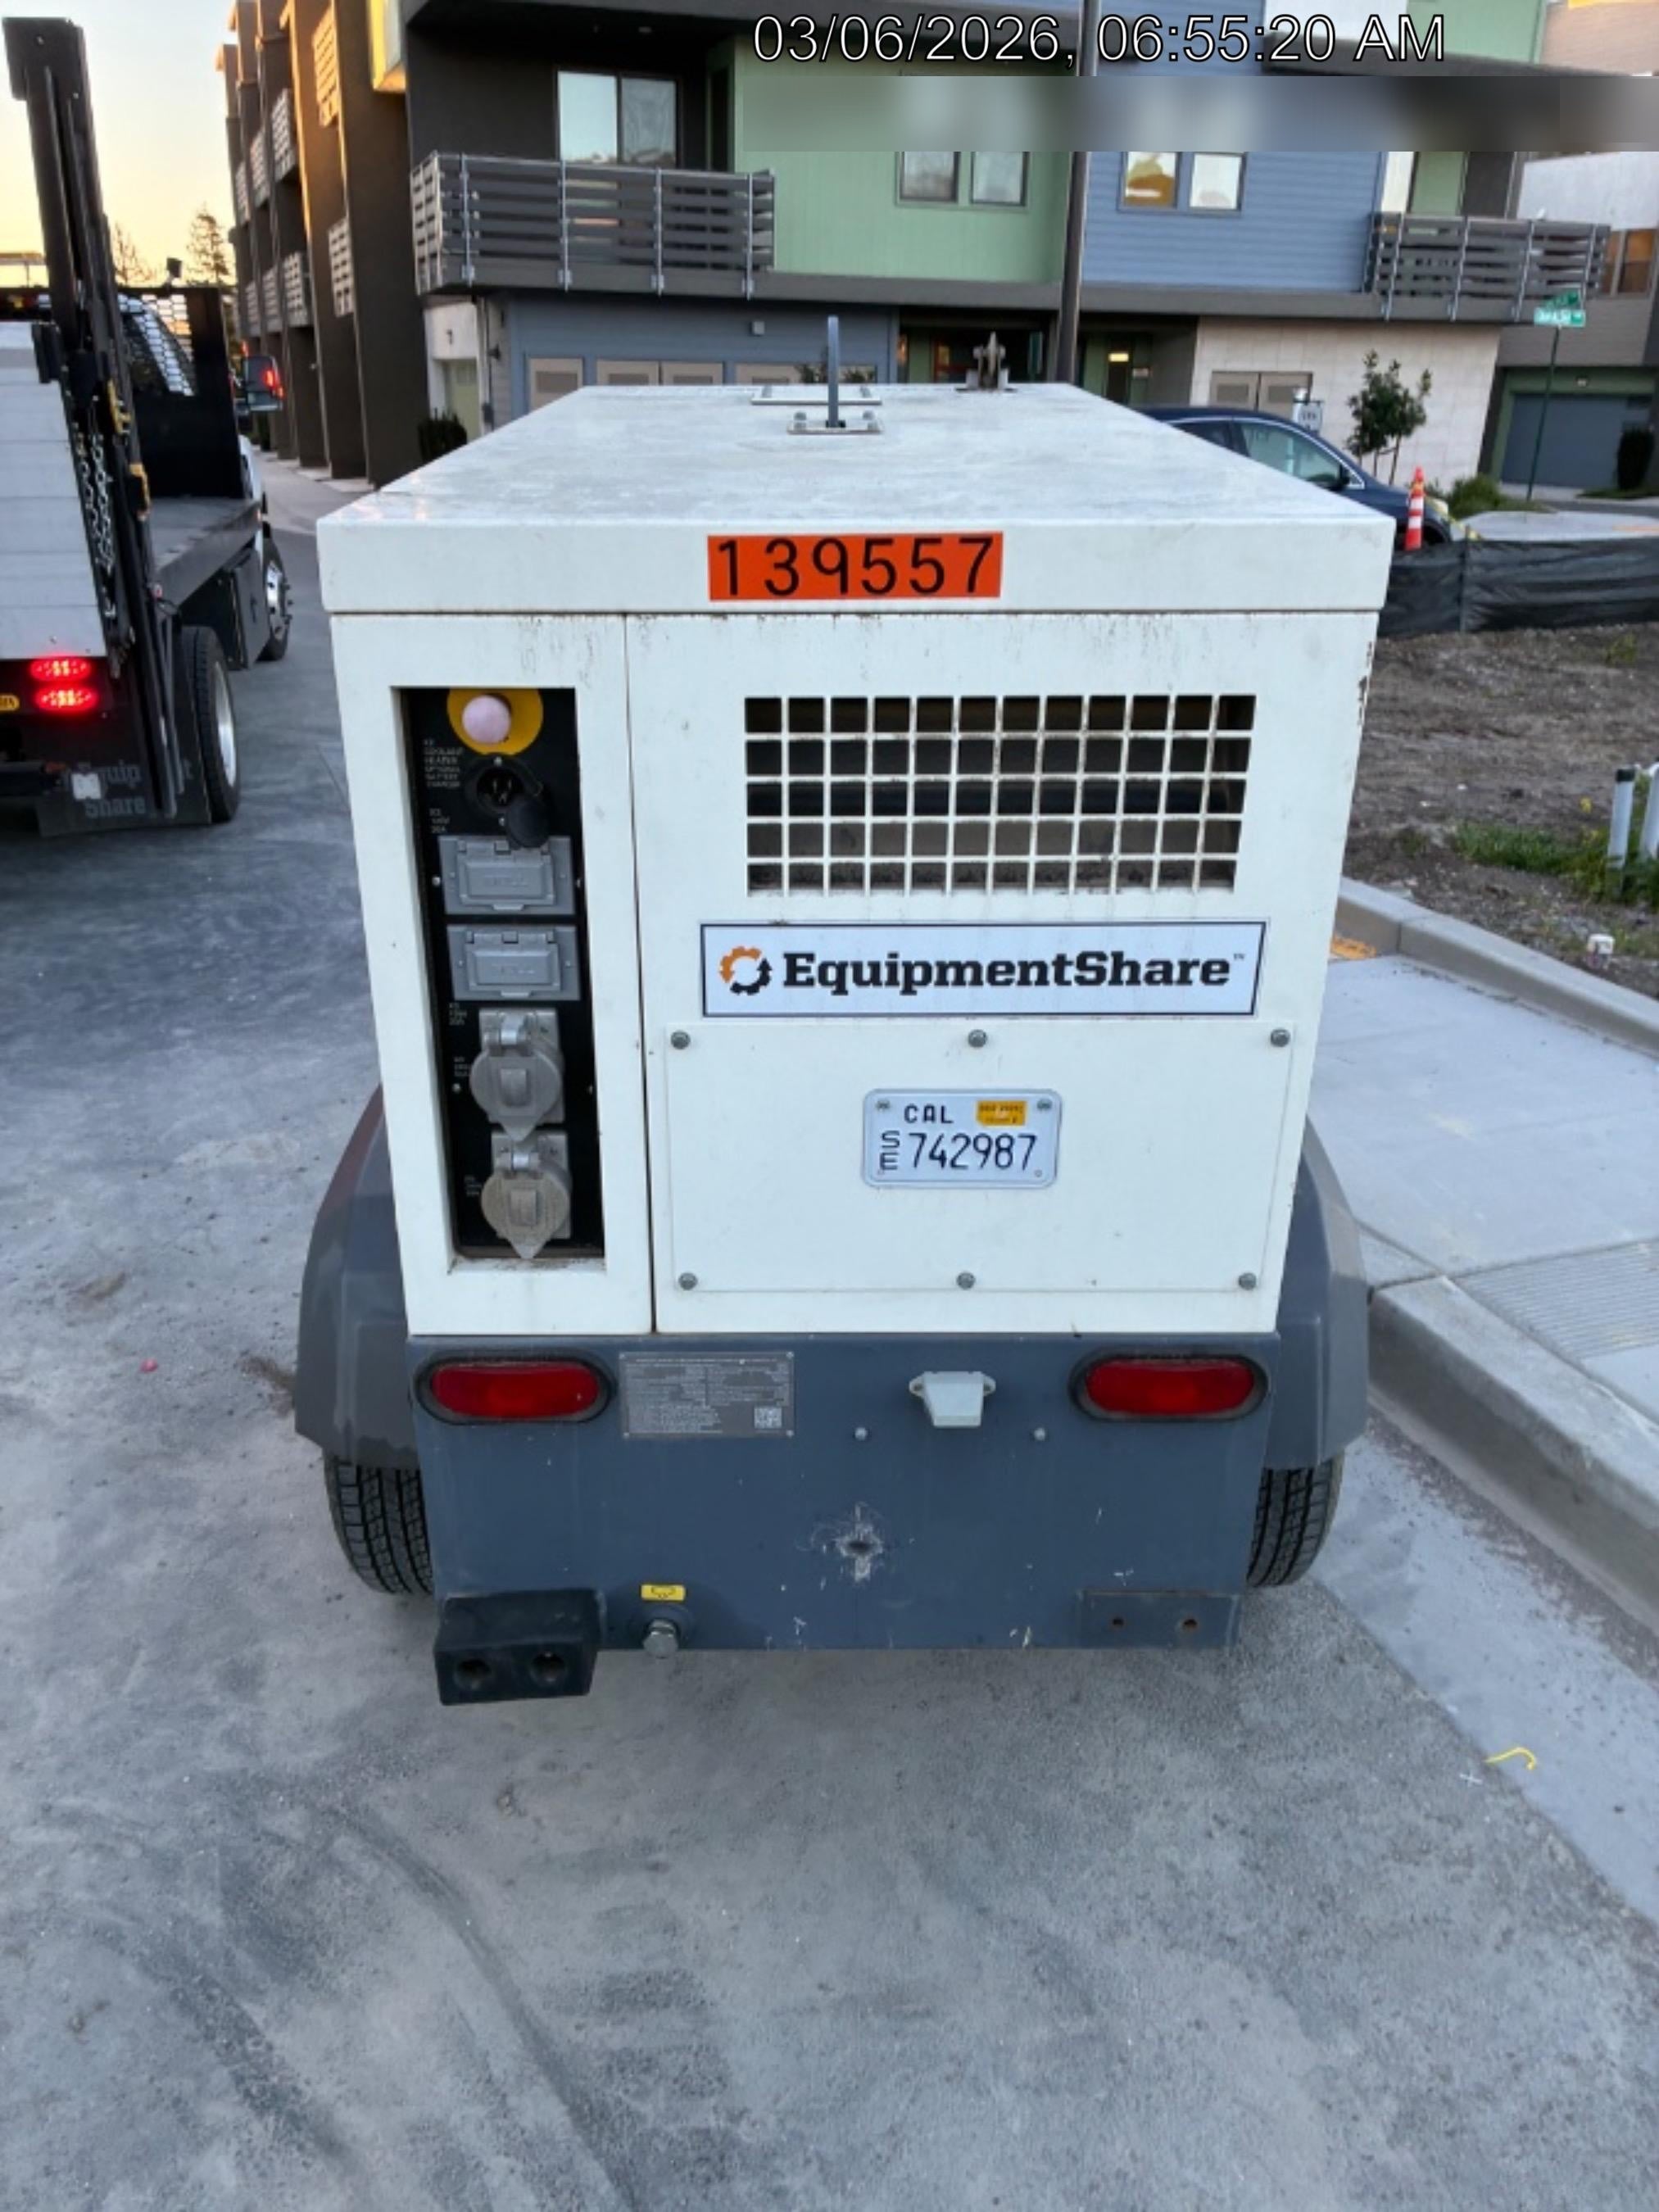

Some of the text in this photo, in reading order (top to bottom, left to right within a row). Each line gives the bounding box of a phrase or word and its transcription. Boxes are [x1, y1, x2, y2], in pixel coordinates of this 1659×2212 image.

[718, 537, 993, 596] 139557
[782, 950, 1230, 995] EquipmentShare
[904, 1103, 954, 1125] CAL
[908, 1131, 1038, 1172] 742987
